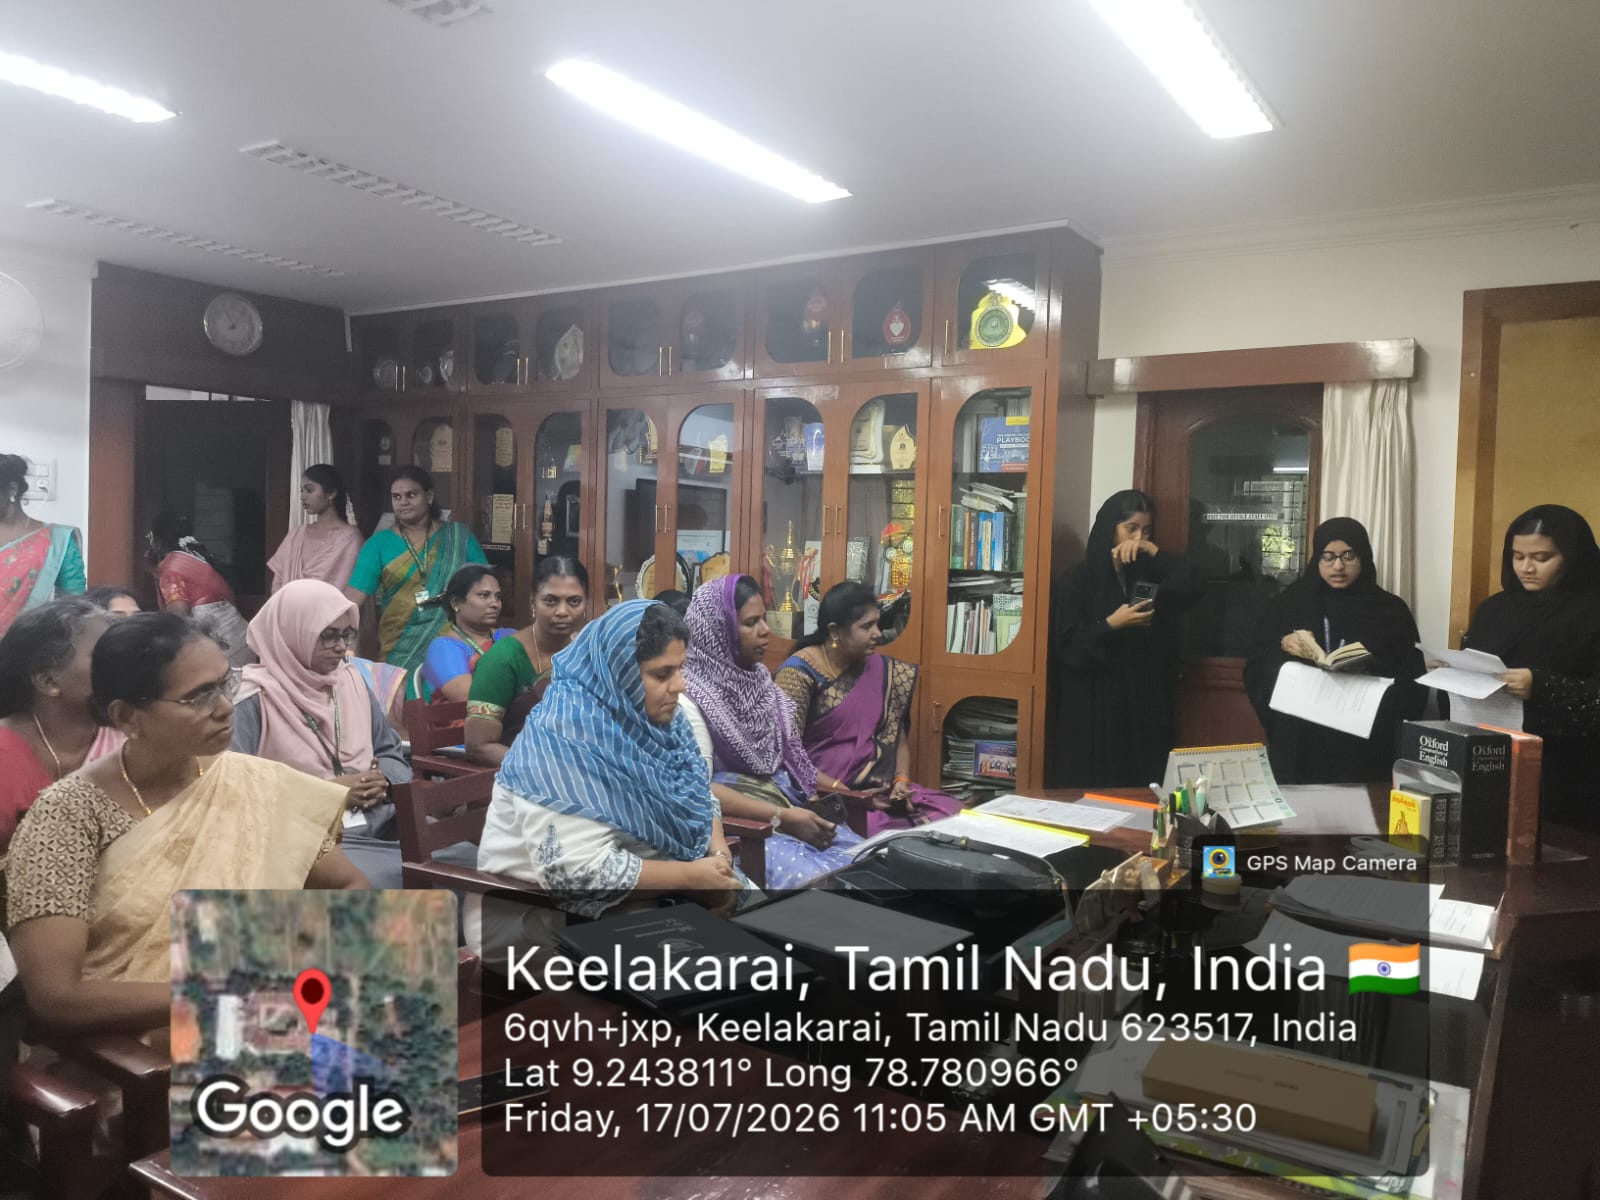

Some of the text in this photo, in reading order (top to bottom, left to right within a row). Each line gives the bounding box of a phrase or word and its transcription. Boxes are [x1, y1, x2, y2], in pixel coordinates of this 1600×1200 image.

[1419, 735, 1449, 752] Oxford
[1472, 744, 1506, 756] Oxford
[1419, 751, 1448, 767] English
[1472, 760, 1505, 773] English
